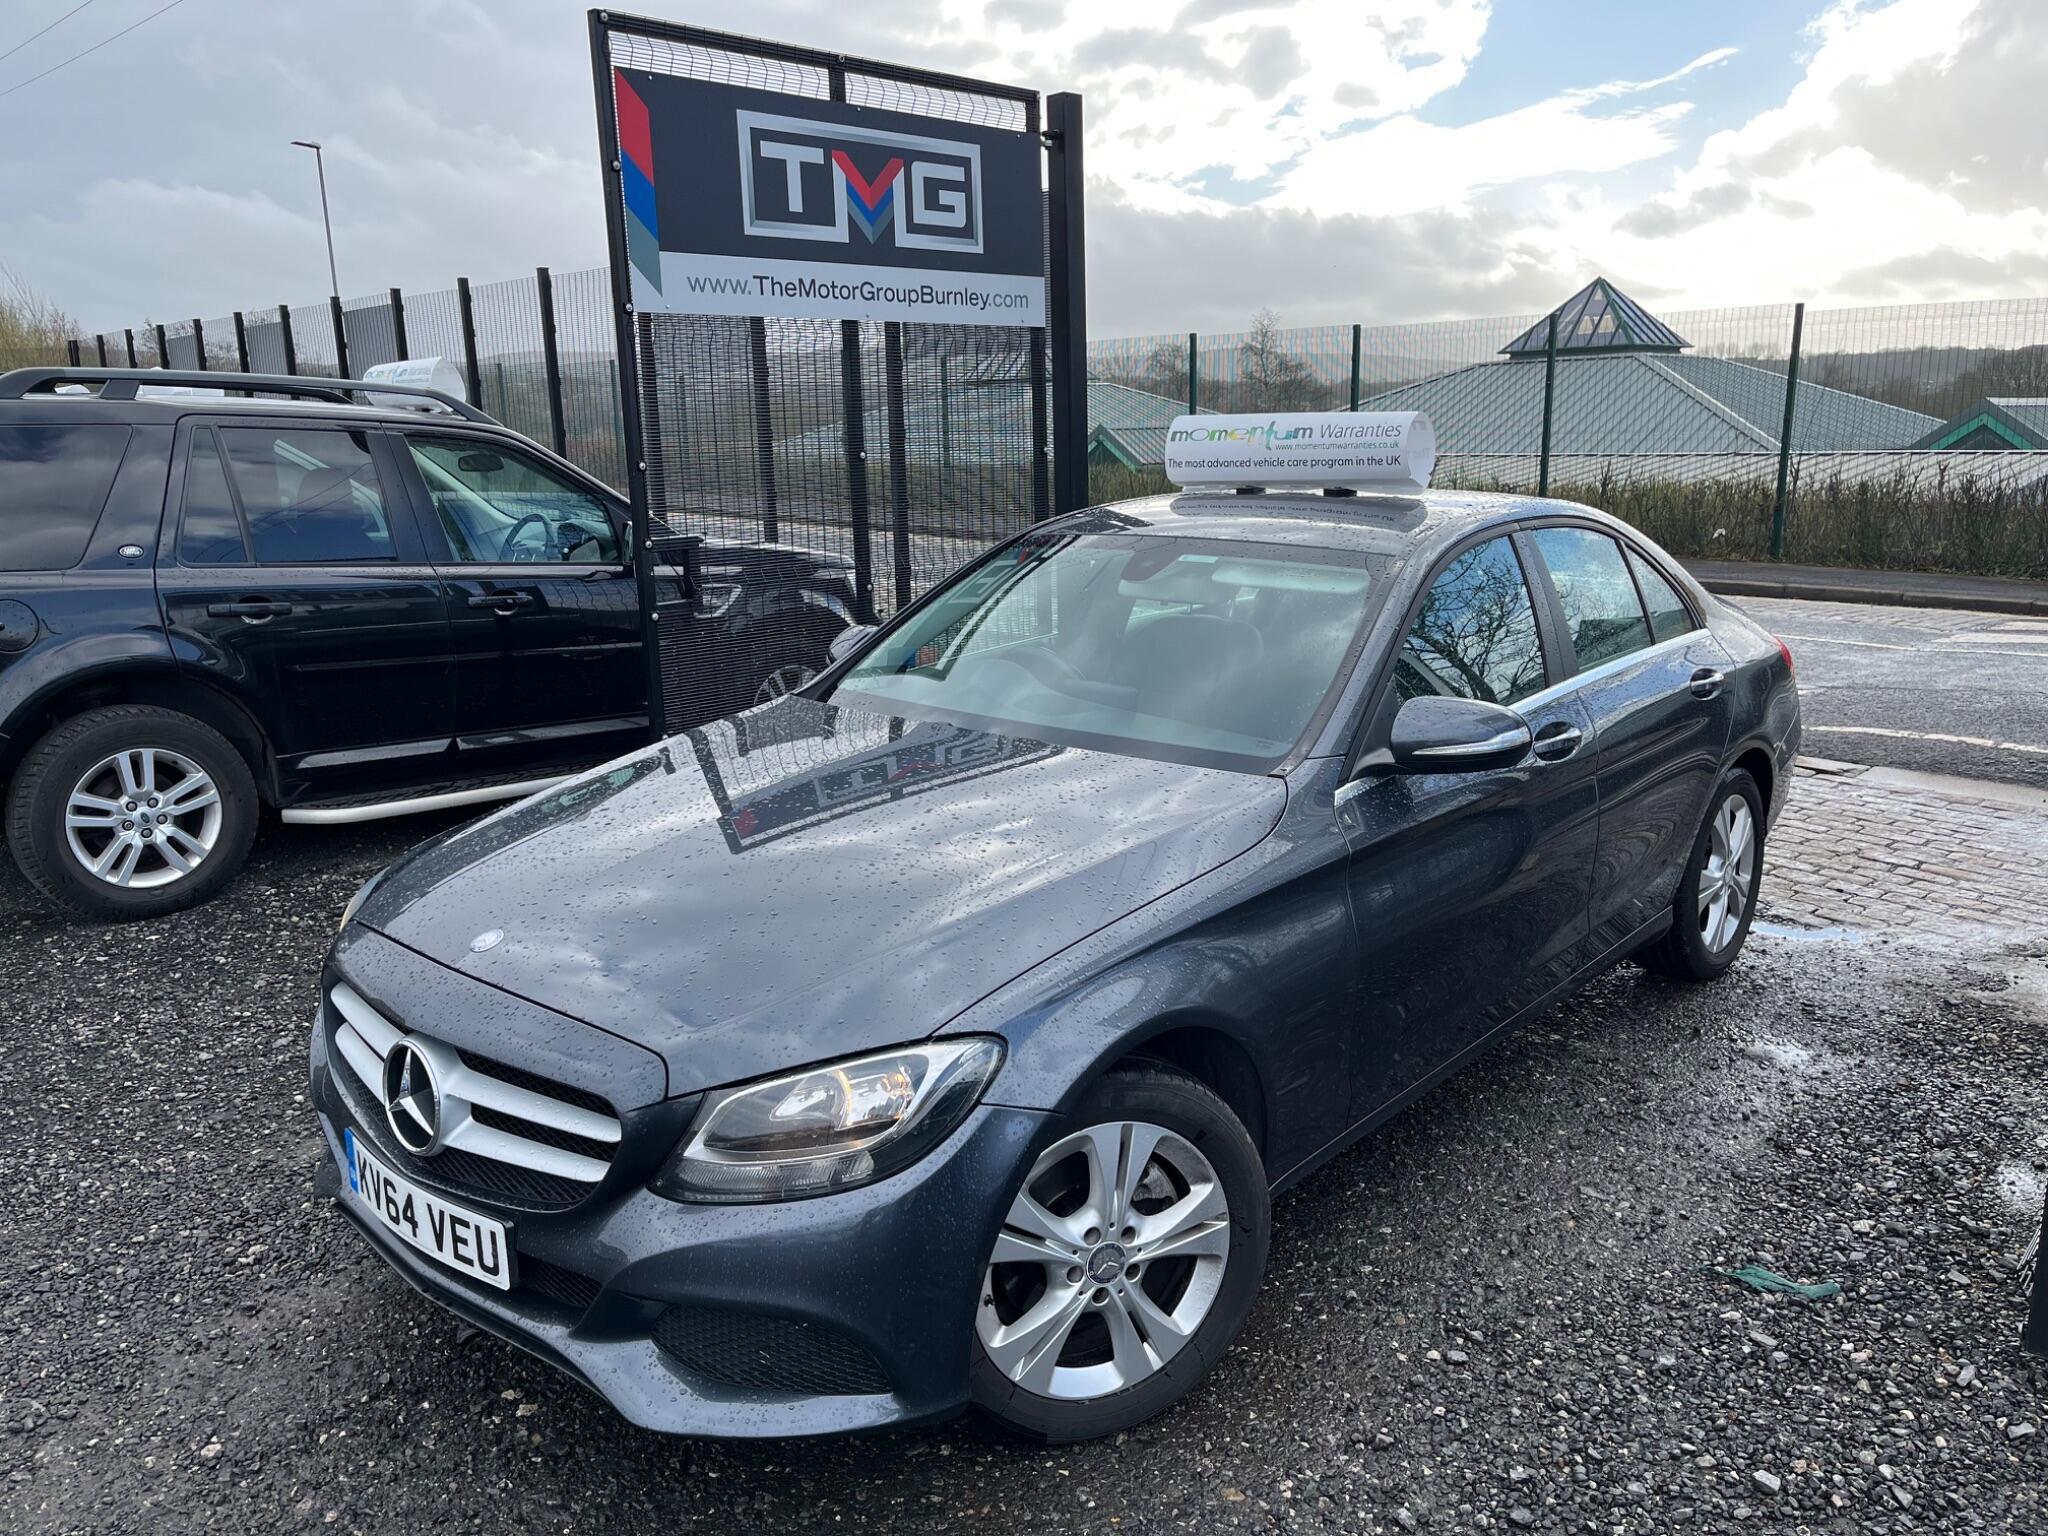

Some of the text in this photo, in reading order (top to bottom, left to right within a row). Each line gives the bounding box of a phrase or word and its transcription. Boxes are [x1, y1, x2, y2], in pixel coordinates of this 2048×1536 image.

[759, 140, 967, 243] TMG
[686, 274, 1030, 310] www.TheMotorGroupBurnley.com
[1170, 421, 1402, 451] momentum Warranties
[1275, 441, 1400, 451] www.momentumwarranties.co.uk
[1168, 455, 1401, 469] The most advanced vehicle care program in the UK
[357, 1151, 500, 1277] KV64 VEU
